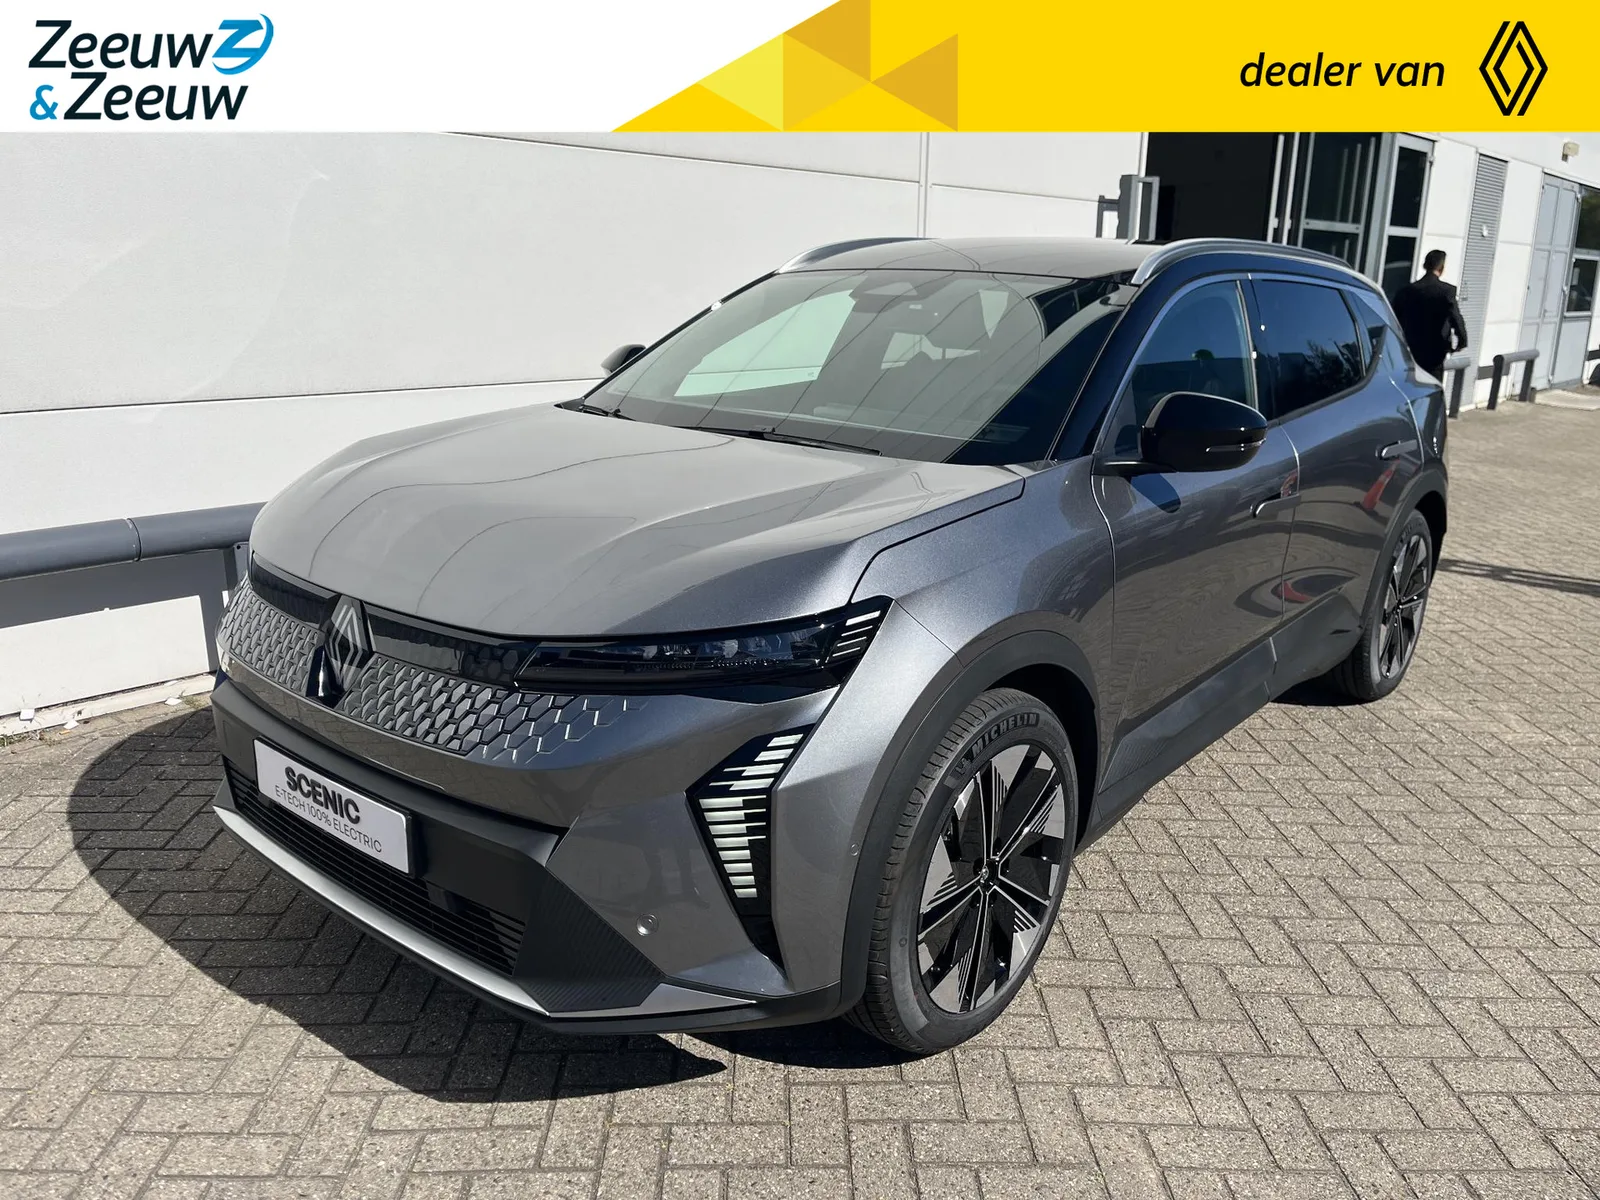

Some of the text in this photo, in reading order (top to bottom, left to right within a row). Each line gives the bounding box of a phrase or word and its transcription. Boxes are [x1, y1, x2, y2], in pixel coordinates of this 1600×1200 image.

[971, 712, 1038, 757] MICHELIN
[274, 784, 382, 853] E-TECH 100% ELECTRIC
[284, 766, 361, 825] SCENIC
